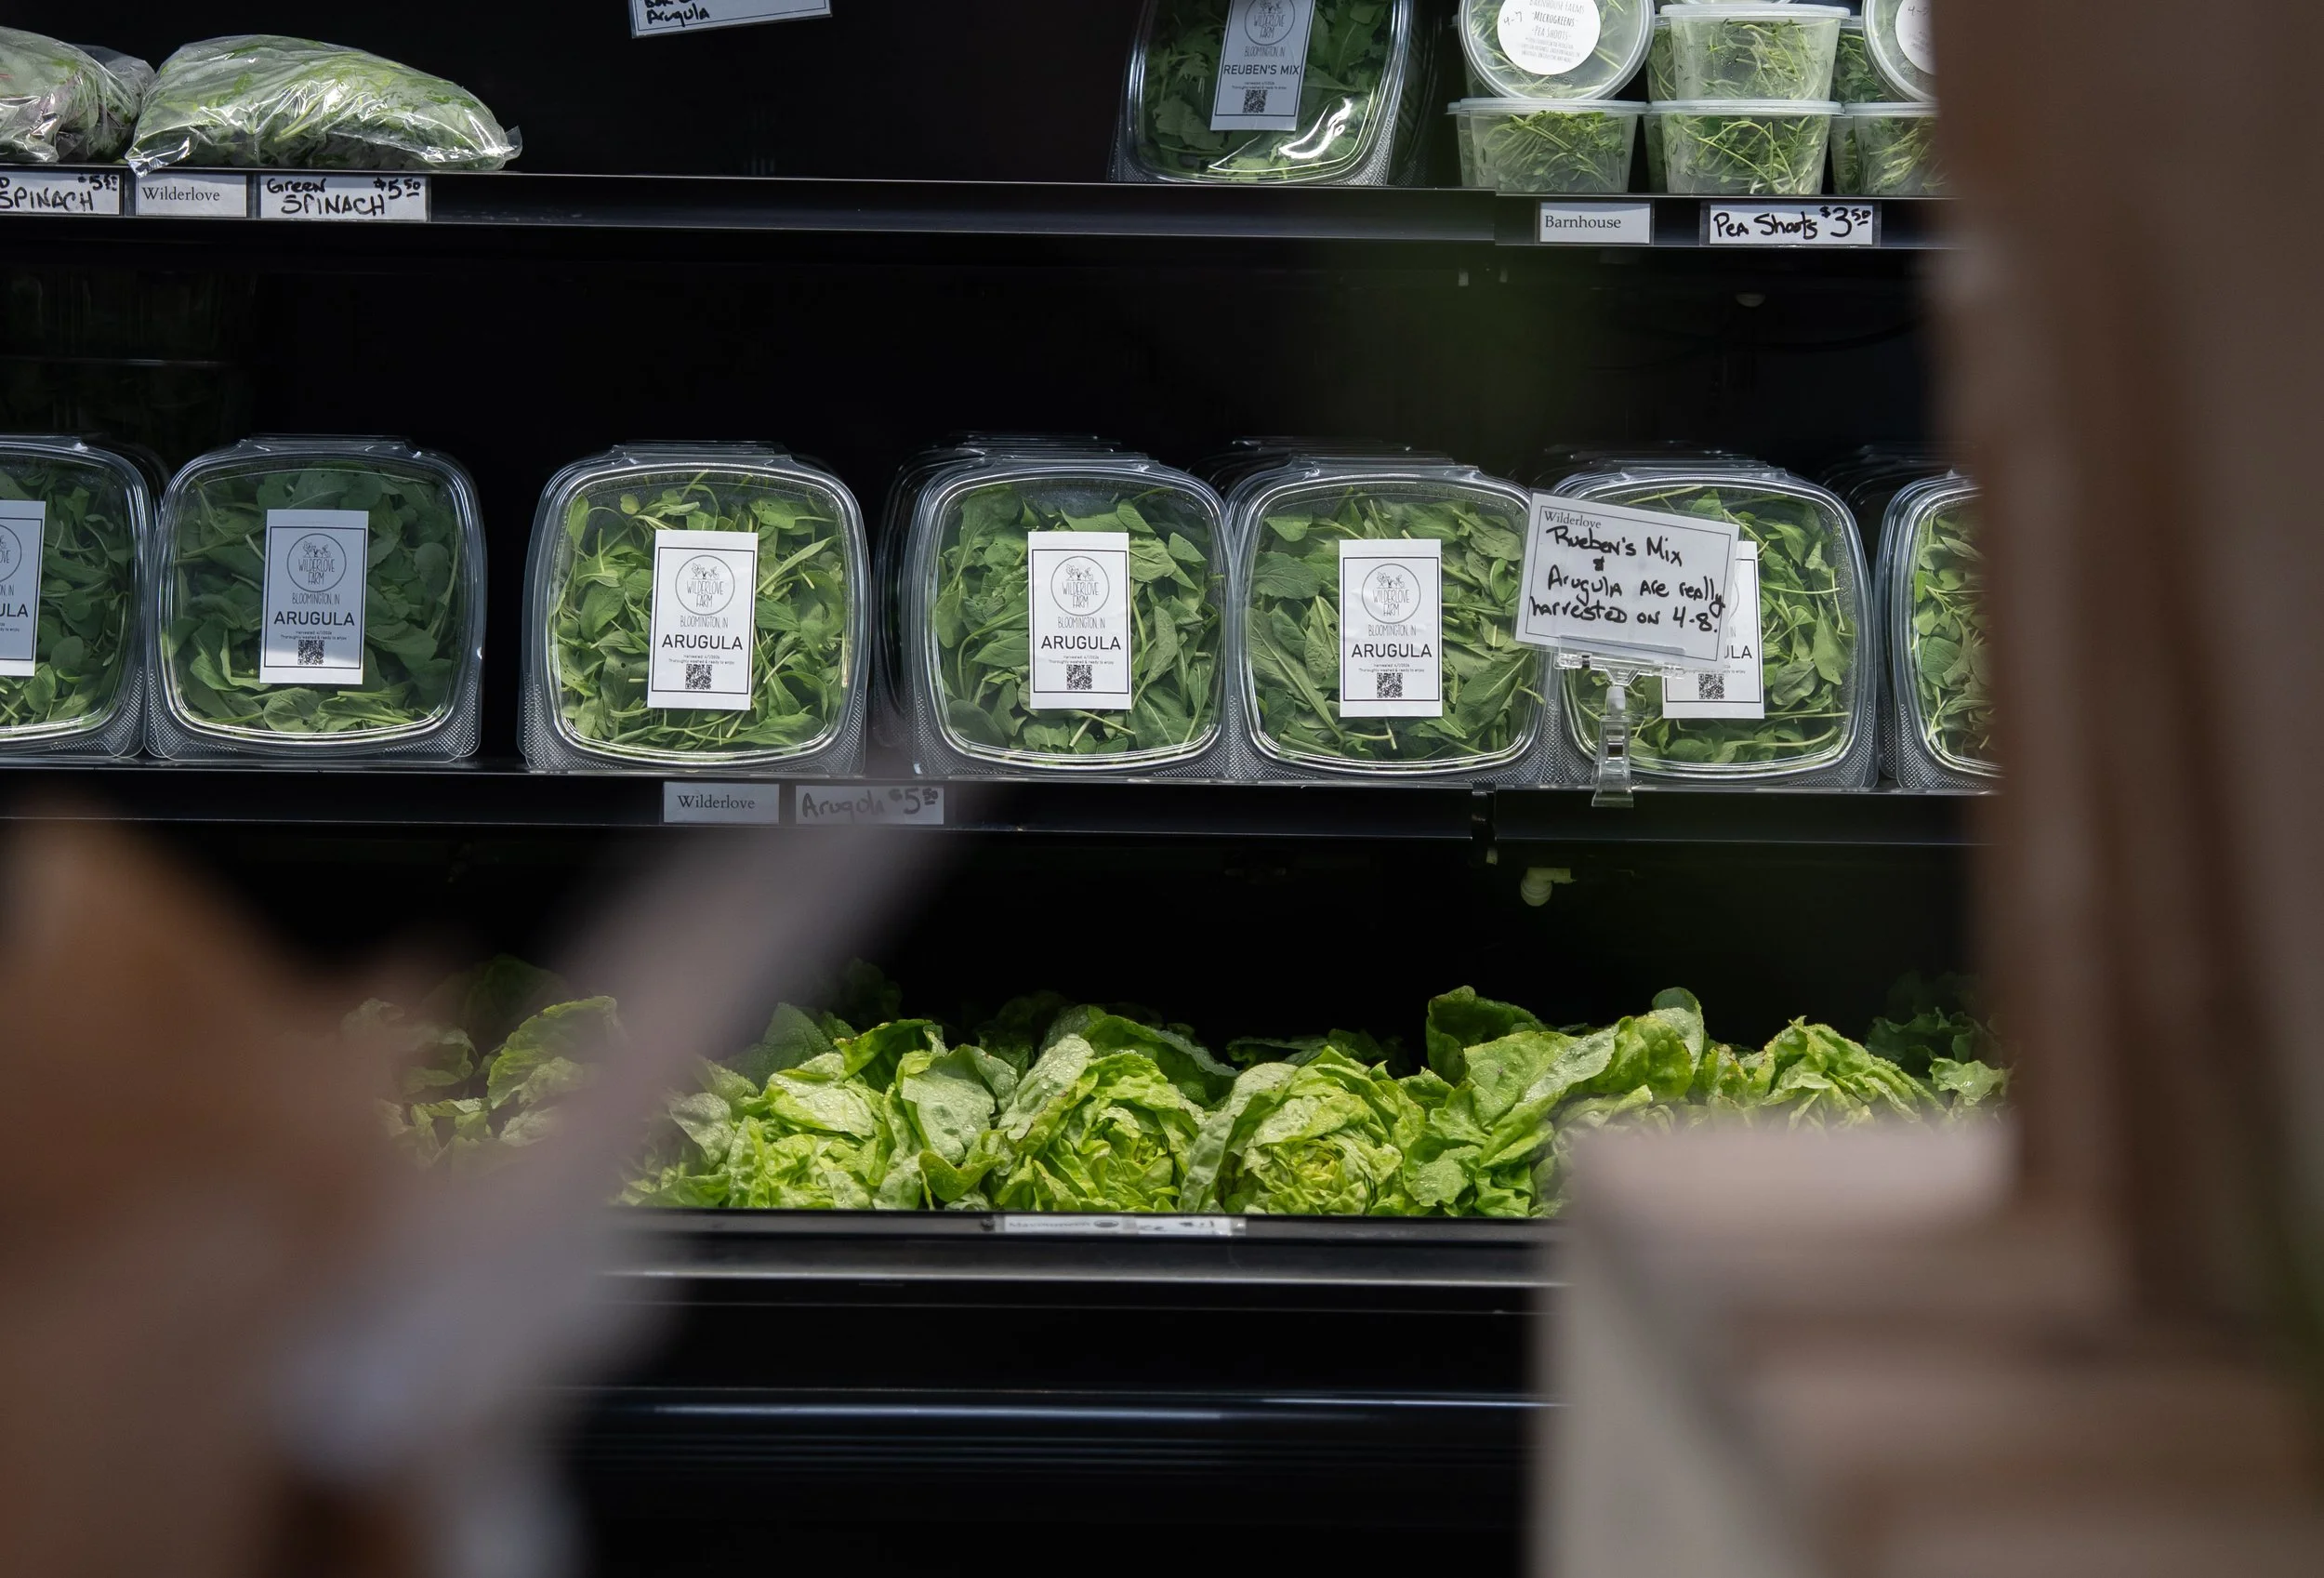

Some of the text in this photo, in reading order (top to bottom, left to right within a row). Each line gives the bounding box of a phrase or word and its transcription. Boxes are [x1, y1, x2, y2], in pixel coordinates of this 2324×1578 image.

[1223, 64, 1301, 75] REUBEN'S MIX
[0, 187, 93, 212] SPINACH
[141, 186, 220, 201] Wilderlove
[281, 193, 385, 216] SPINACH
[1545, 215, 1621, 229] Barnhouse
[1544, 511, 1602, 529] Wilderlove
[1646, 536, 1683, 567] Mix
[1548, 564, 1622, 606] Arugula
[1679, 576, 1725, 618] really
[273, 611, 355, 626] ARUGULA
[662, 634, 743, 650] ARUGULA
[1040, 635, 1121, 650] ARUGULA
[1352, 643, 1433, 657] ARUGULA
[677, 794, 755, 809] Wilderlove
